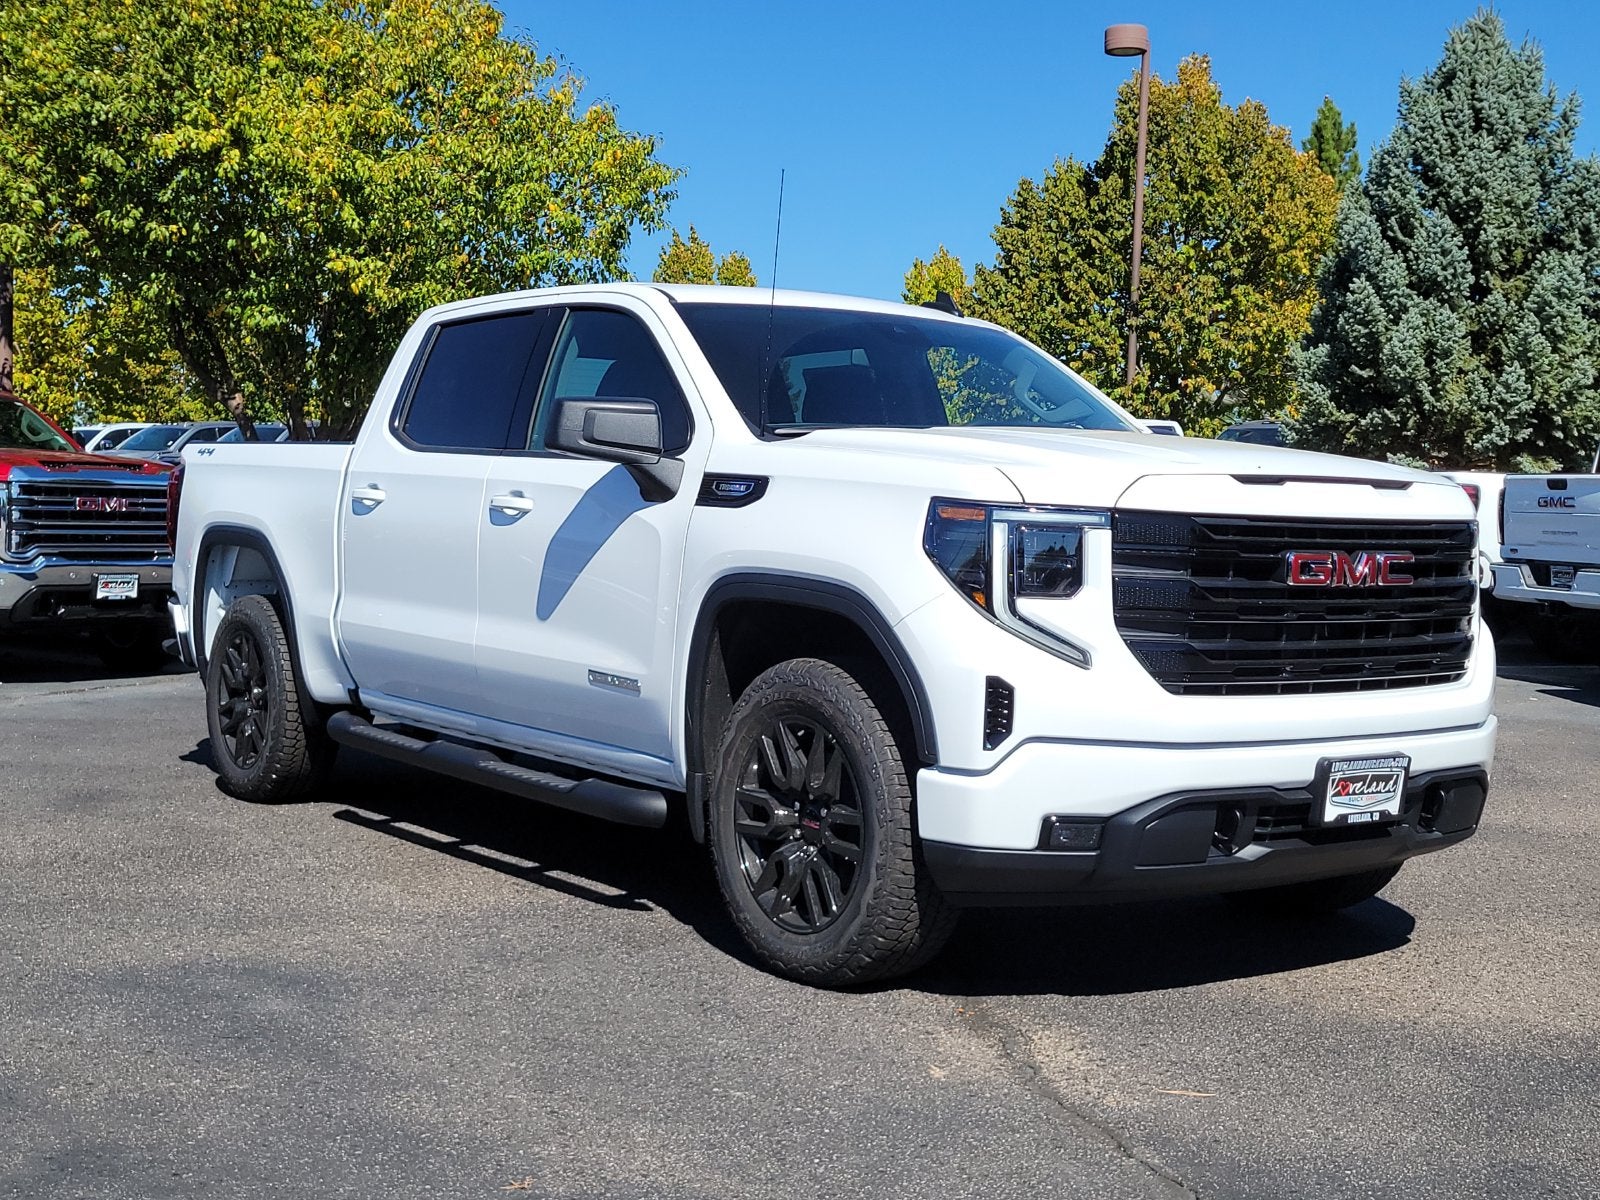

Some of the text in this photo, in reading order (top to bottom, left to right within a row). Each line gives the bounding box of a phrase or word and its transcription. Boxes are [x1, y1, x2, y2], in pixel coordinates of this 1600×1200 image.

[76, 497, 140, 511] GMC
[1537, 496, 1577, 508] GMC
[1286, 551, 1415, 587] GMC
